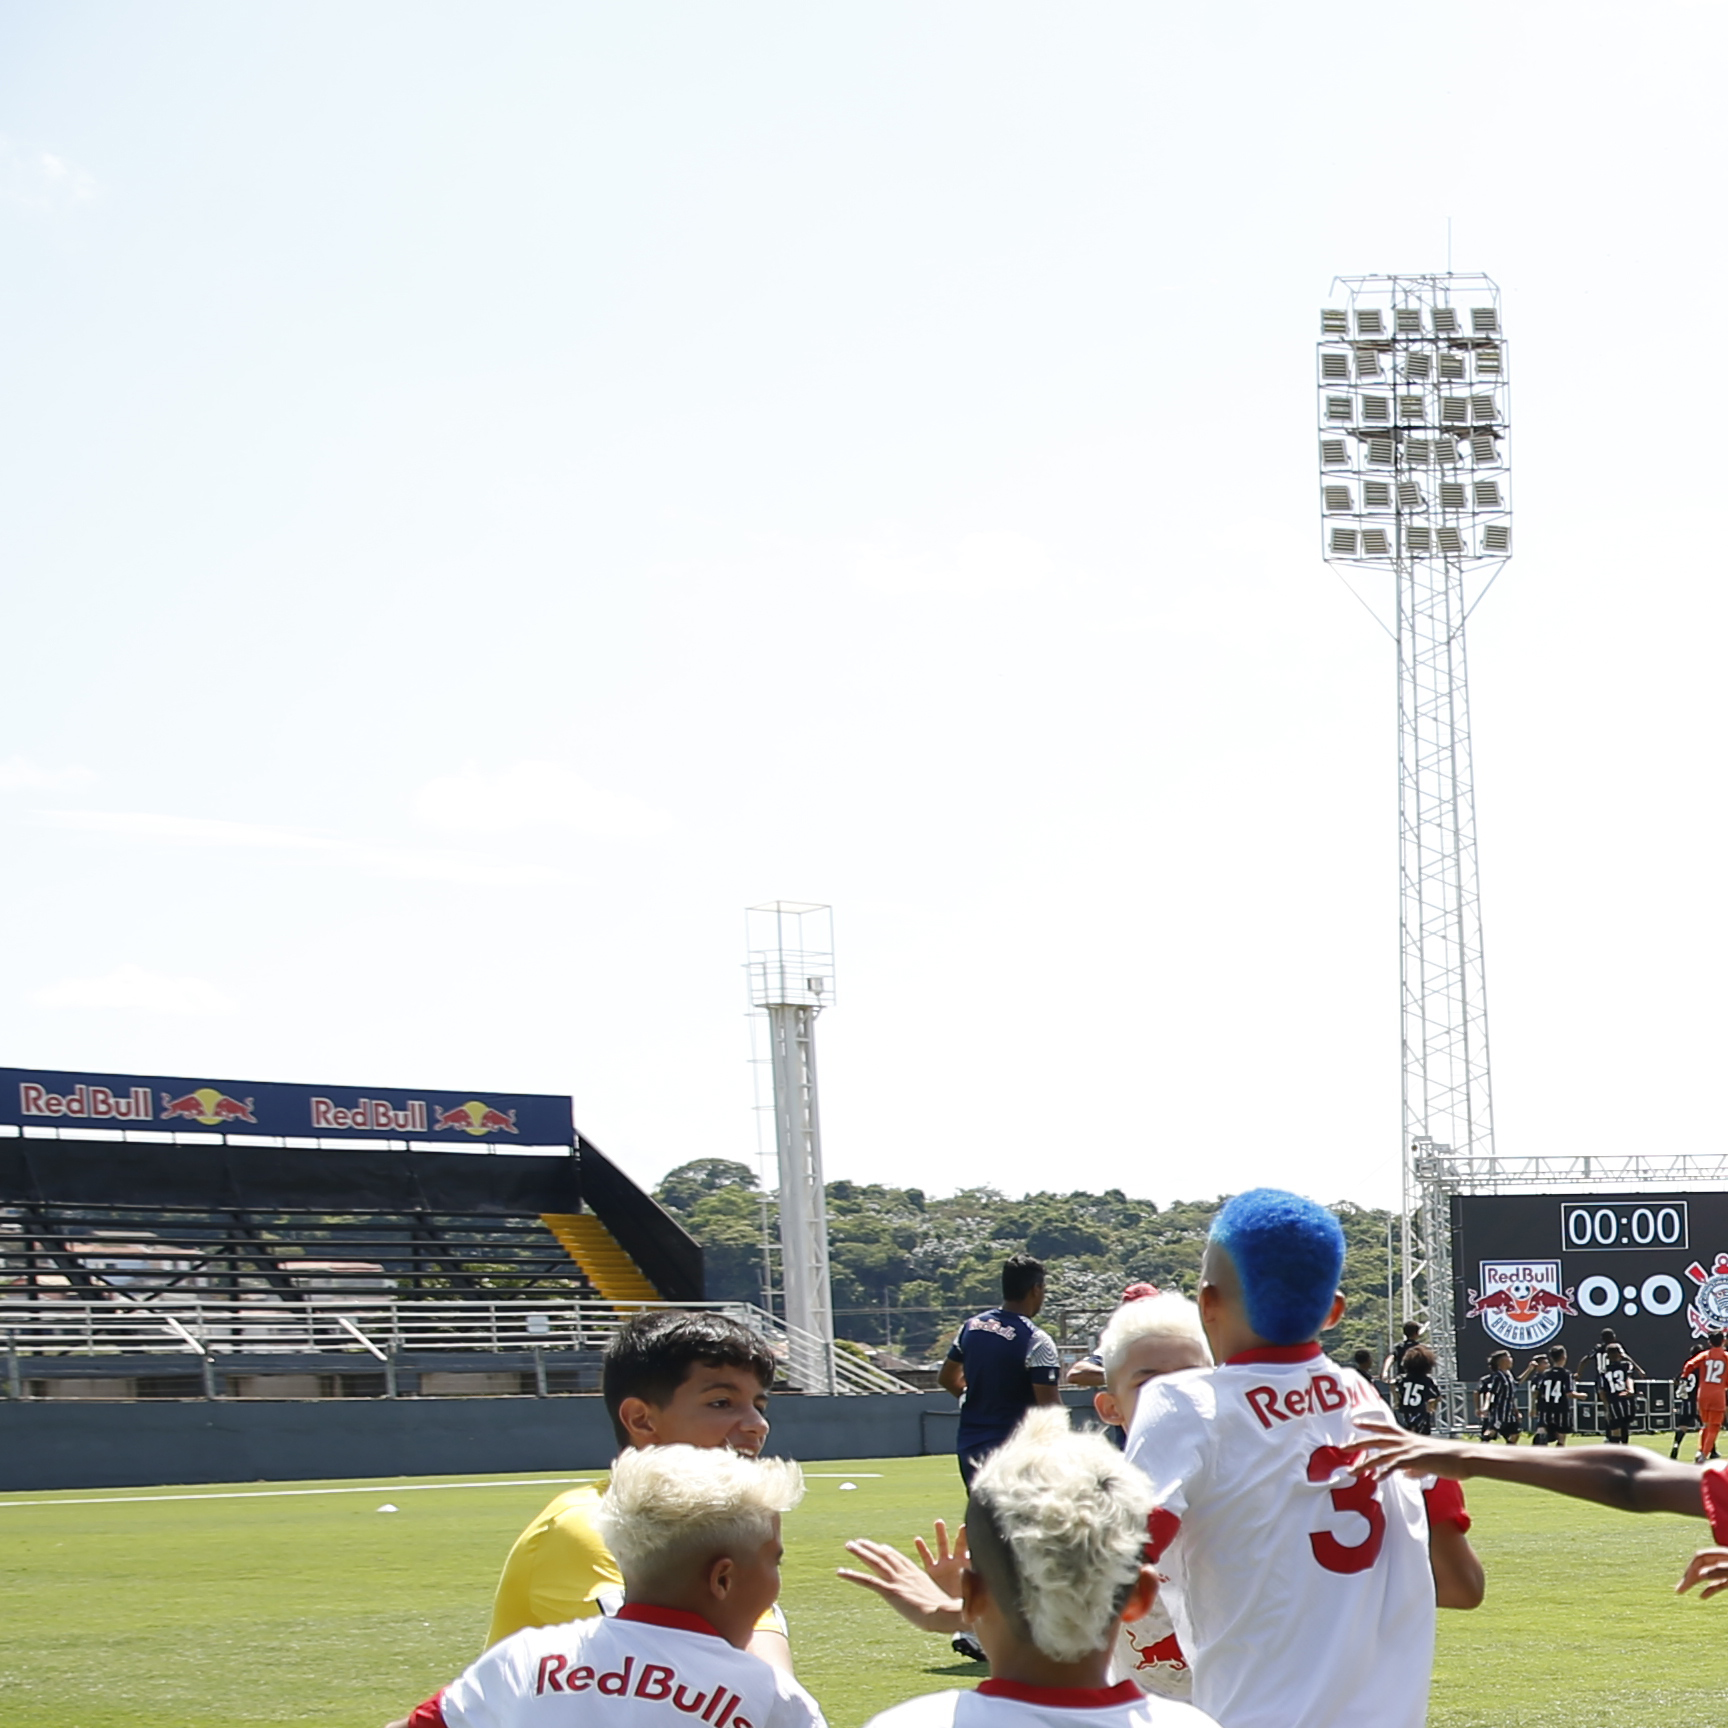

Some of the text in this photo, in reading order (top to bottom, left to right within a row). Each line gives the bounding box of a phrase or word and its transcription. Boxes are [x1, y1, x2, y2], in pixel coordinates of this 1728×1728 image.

[1568, 1208, 1681, 1245] 00:00
[1577, 1274, 1683, 1317] 0:0
[1490, 1316, 1557, 1342] BRAGANTINO
[1604, 1370, 1626, 1393] 13
[1704, 1359, 1725, 1384] 12
[1402, 1382, 1425, 1407] 15
[1543, 1379, 1562, 1404] 14
[1307, 1445, 1386, 1575] 3
